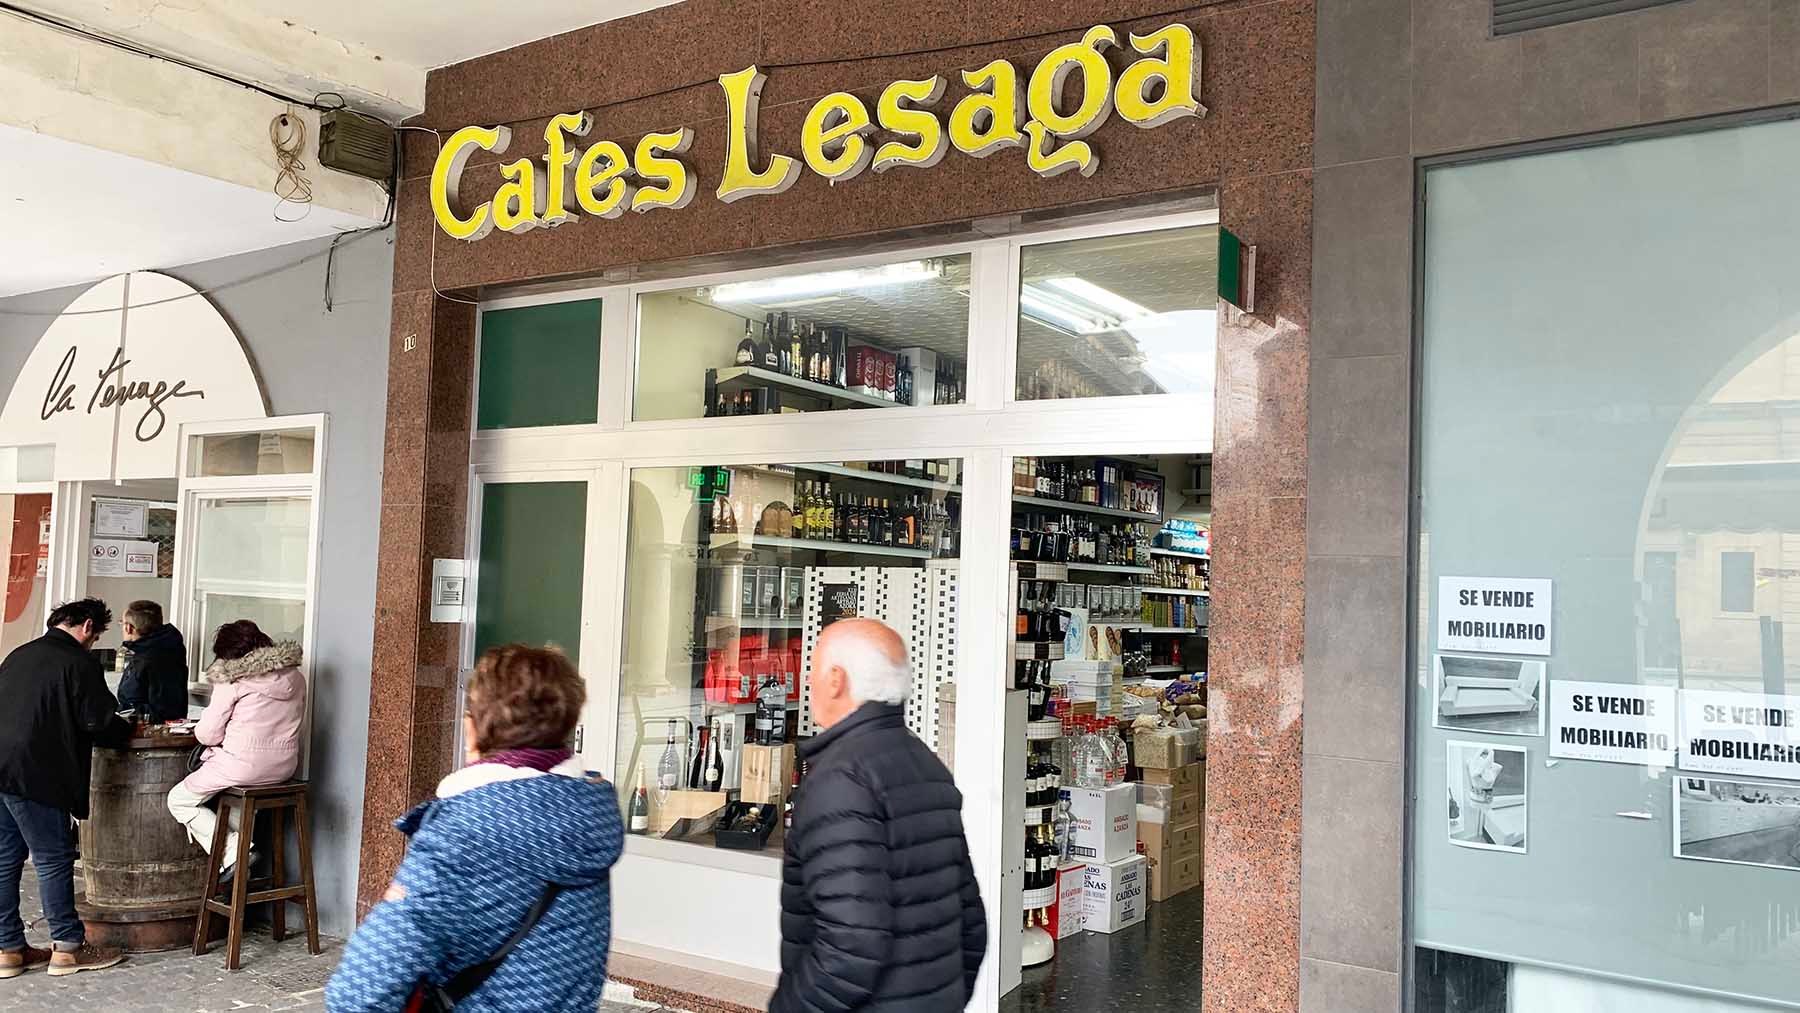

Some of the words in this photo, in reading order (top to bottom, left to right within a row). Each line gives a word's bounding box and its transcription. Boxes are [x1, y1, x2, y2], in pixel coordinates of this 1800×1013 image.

[430, 111, 691, 241] Cafes
[717, 25, 1202, 203] Lesaga
[405, 335, 416, 350] 10
[1459, 589, 1478, 606] SE
[1482, 590, 1534, 608] VENDE
[1448, 620, 1545, 640] MOBILIARIO
[1572, 694, 1593, 713] SE
[1598, 696, 1656, 717] VENDE
[1703, 704, 1726, 724] SE
[1732, 707, 1794, 728] VENDE
[1561, 726, 1668, 751] MOBILIARIO
[1116, 886, 1141, 902] CADENAS
